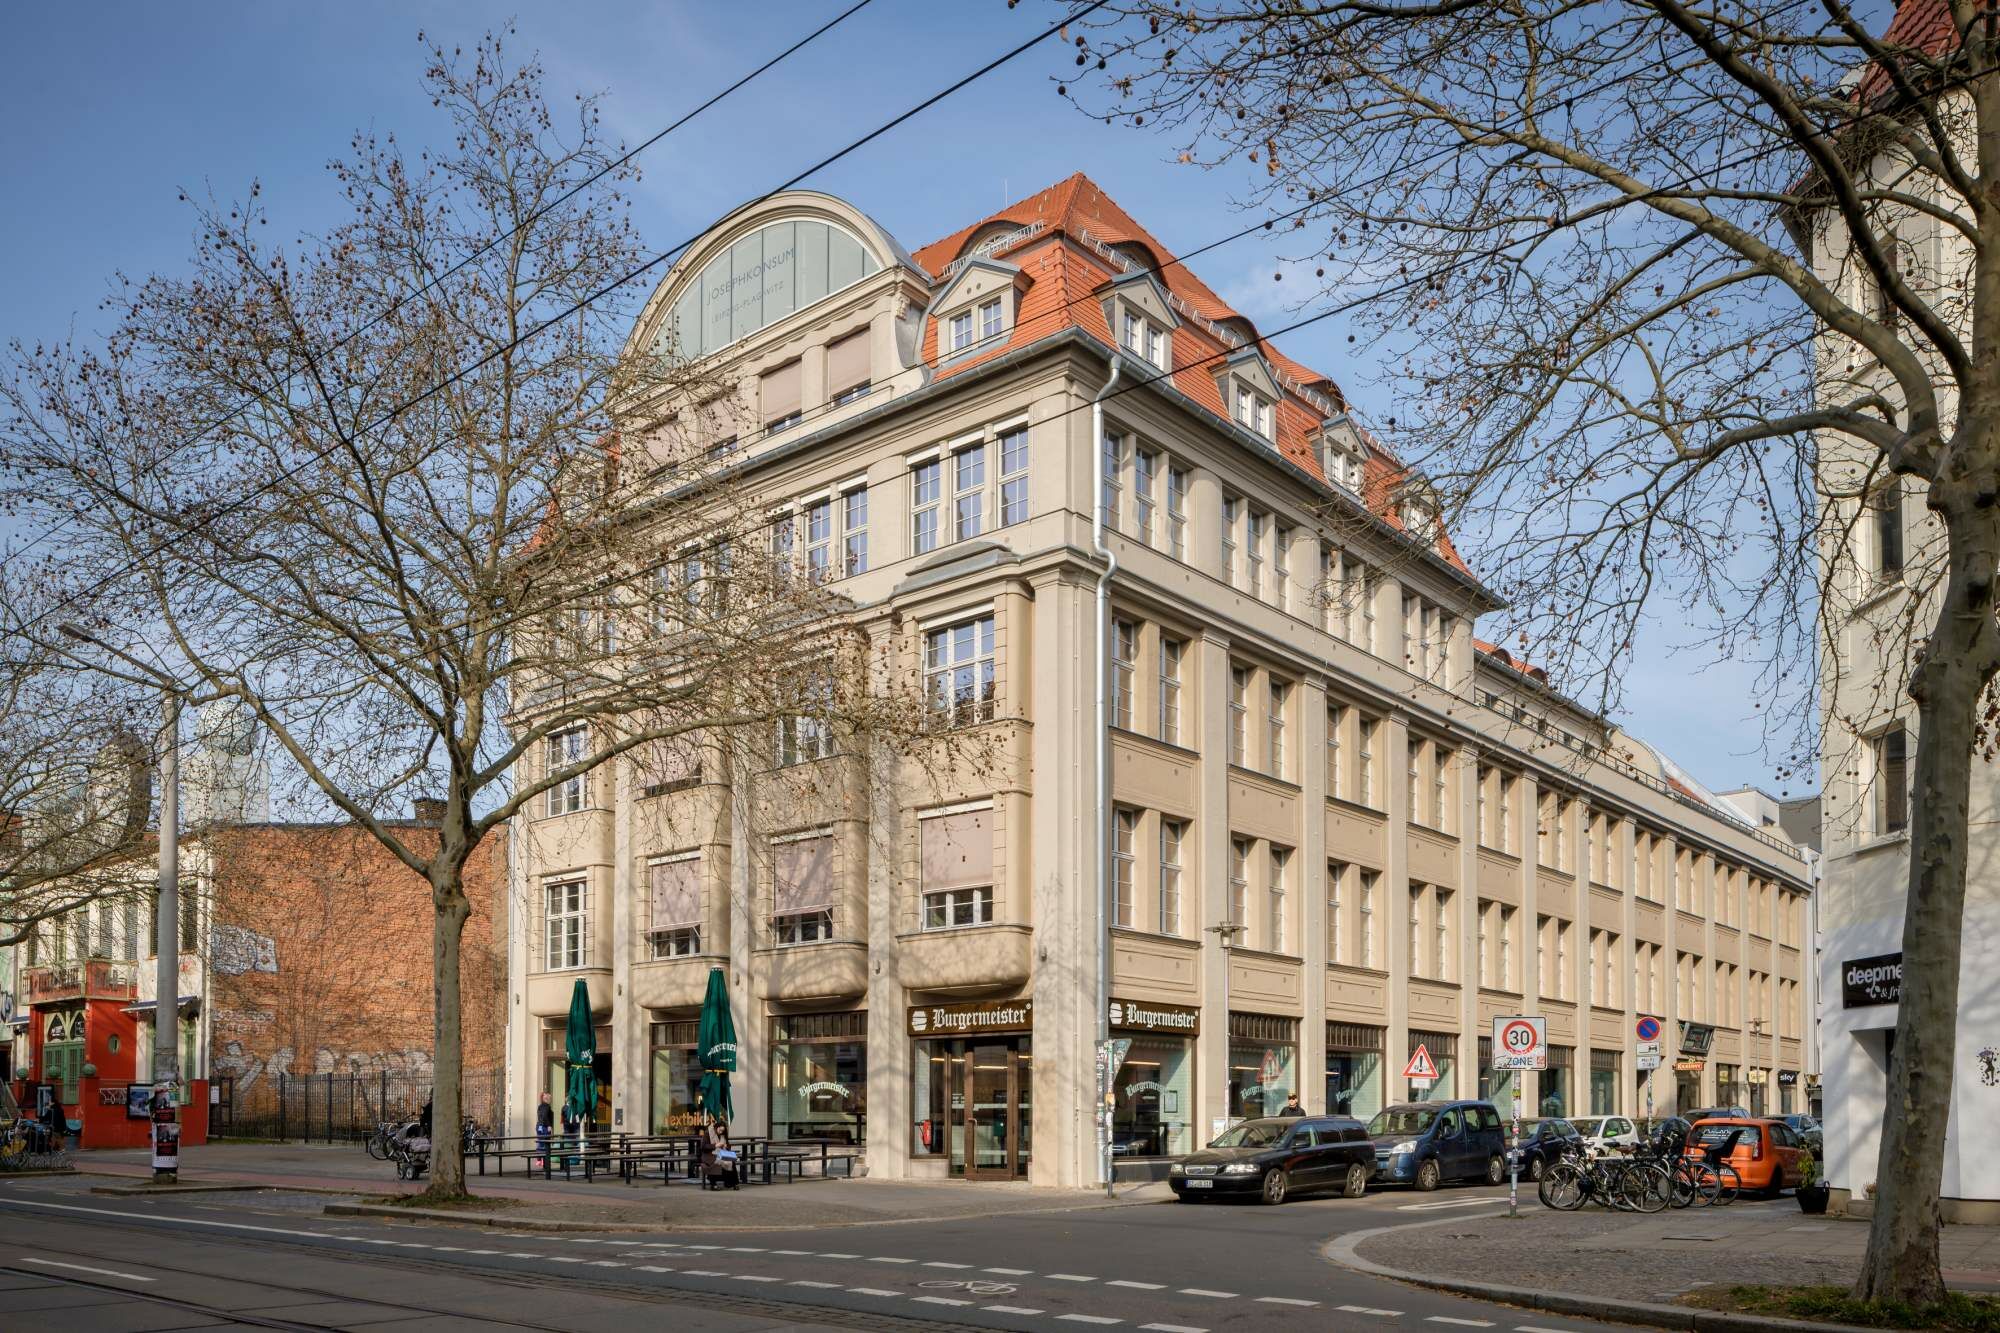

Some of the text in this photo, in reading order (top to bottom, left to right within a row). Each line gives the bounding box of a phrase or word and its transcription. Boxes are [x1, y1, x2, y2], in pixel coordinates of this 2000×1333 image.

[706, 248, 795, 306] JOSEPHKONSUM
[711, 280, 784, 324] LEIPZG-PLAGWITZ
[932, 1006, 1026, 1031] Burgermeister
[1126, 1003, 1196, 1028] Burgermeister
[1510, 1030, 1530, 1046] 30
[1506, 1056, 1533, 1066] ZONE
[1780, 1072, 1795, 1082] sky
